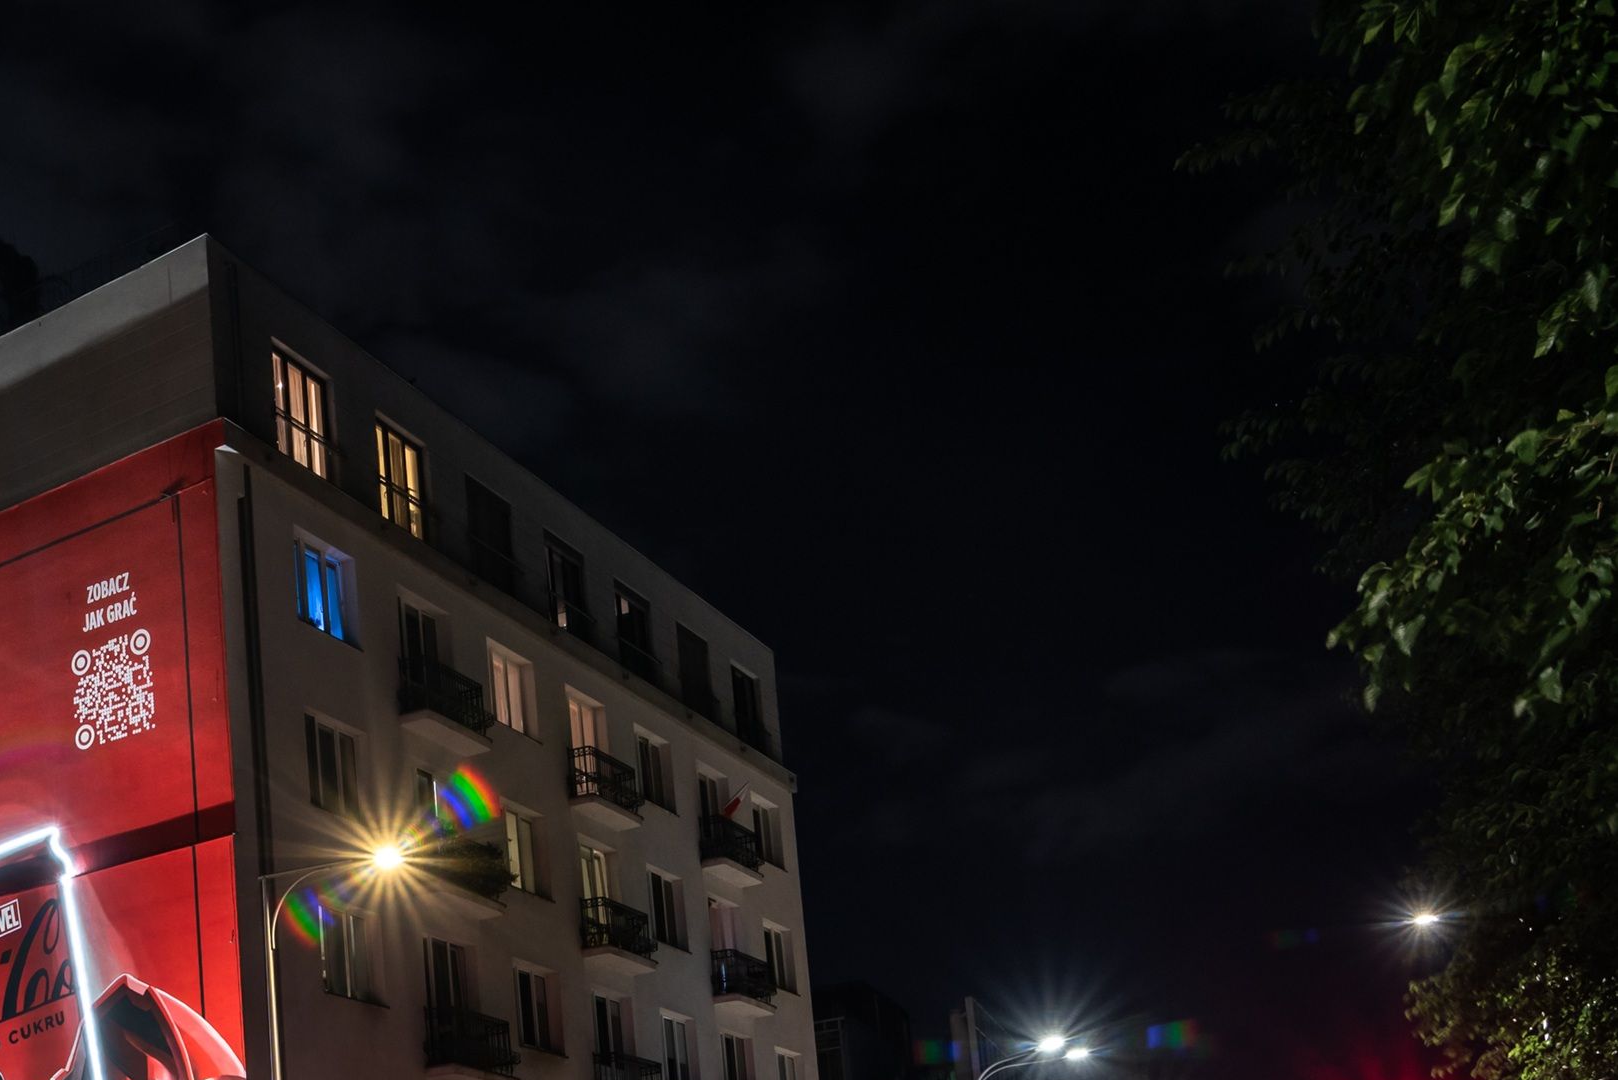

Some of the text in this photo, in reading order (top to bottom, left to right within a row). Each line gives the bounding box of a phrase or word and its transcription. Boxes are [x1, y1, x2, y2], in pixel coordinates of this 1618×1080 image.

[86, 571, 130, 604] ZOBACZ
[82, 591, 138, 633] JAK GRAĆ
[7, 1010, 66, 1045] CUKRU
